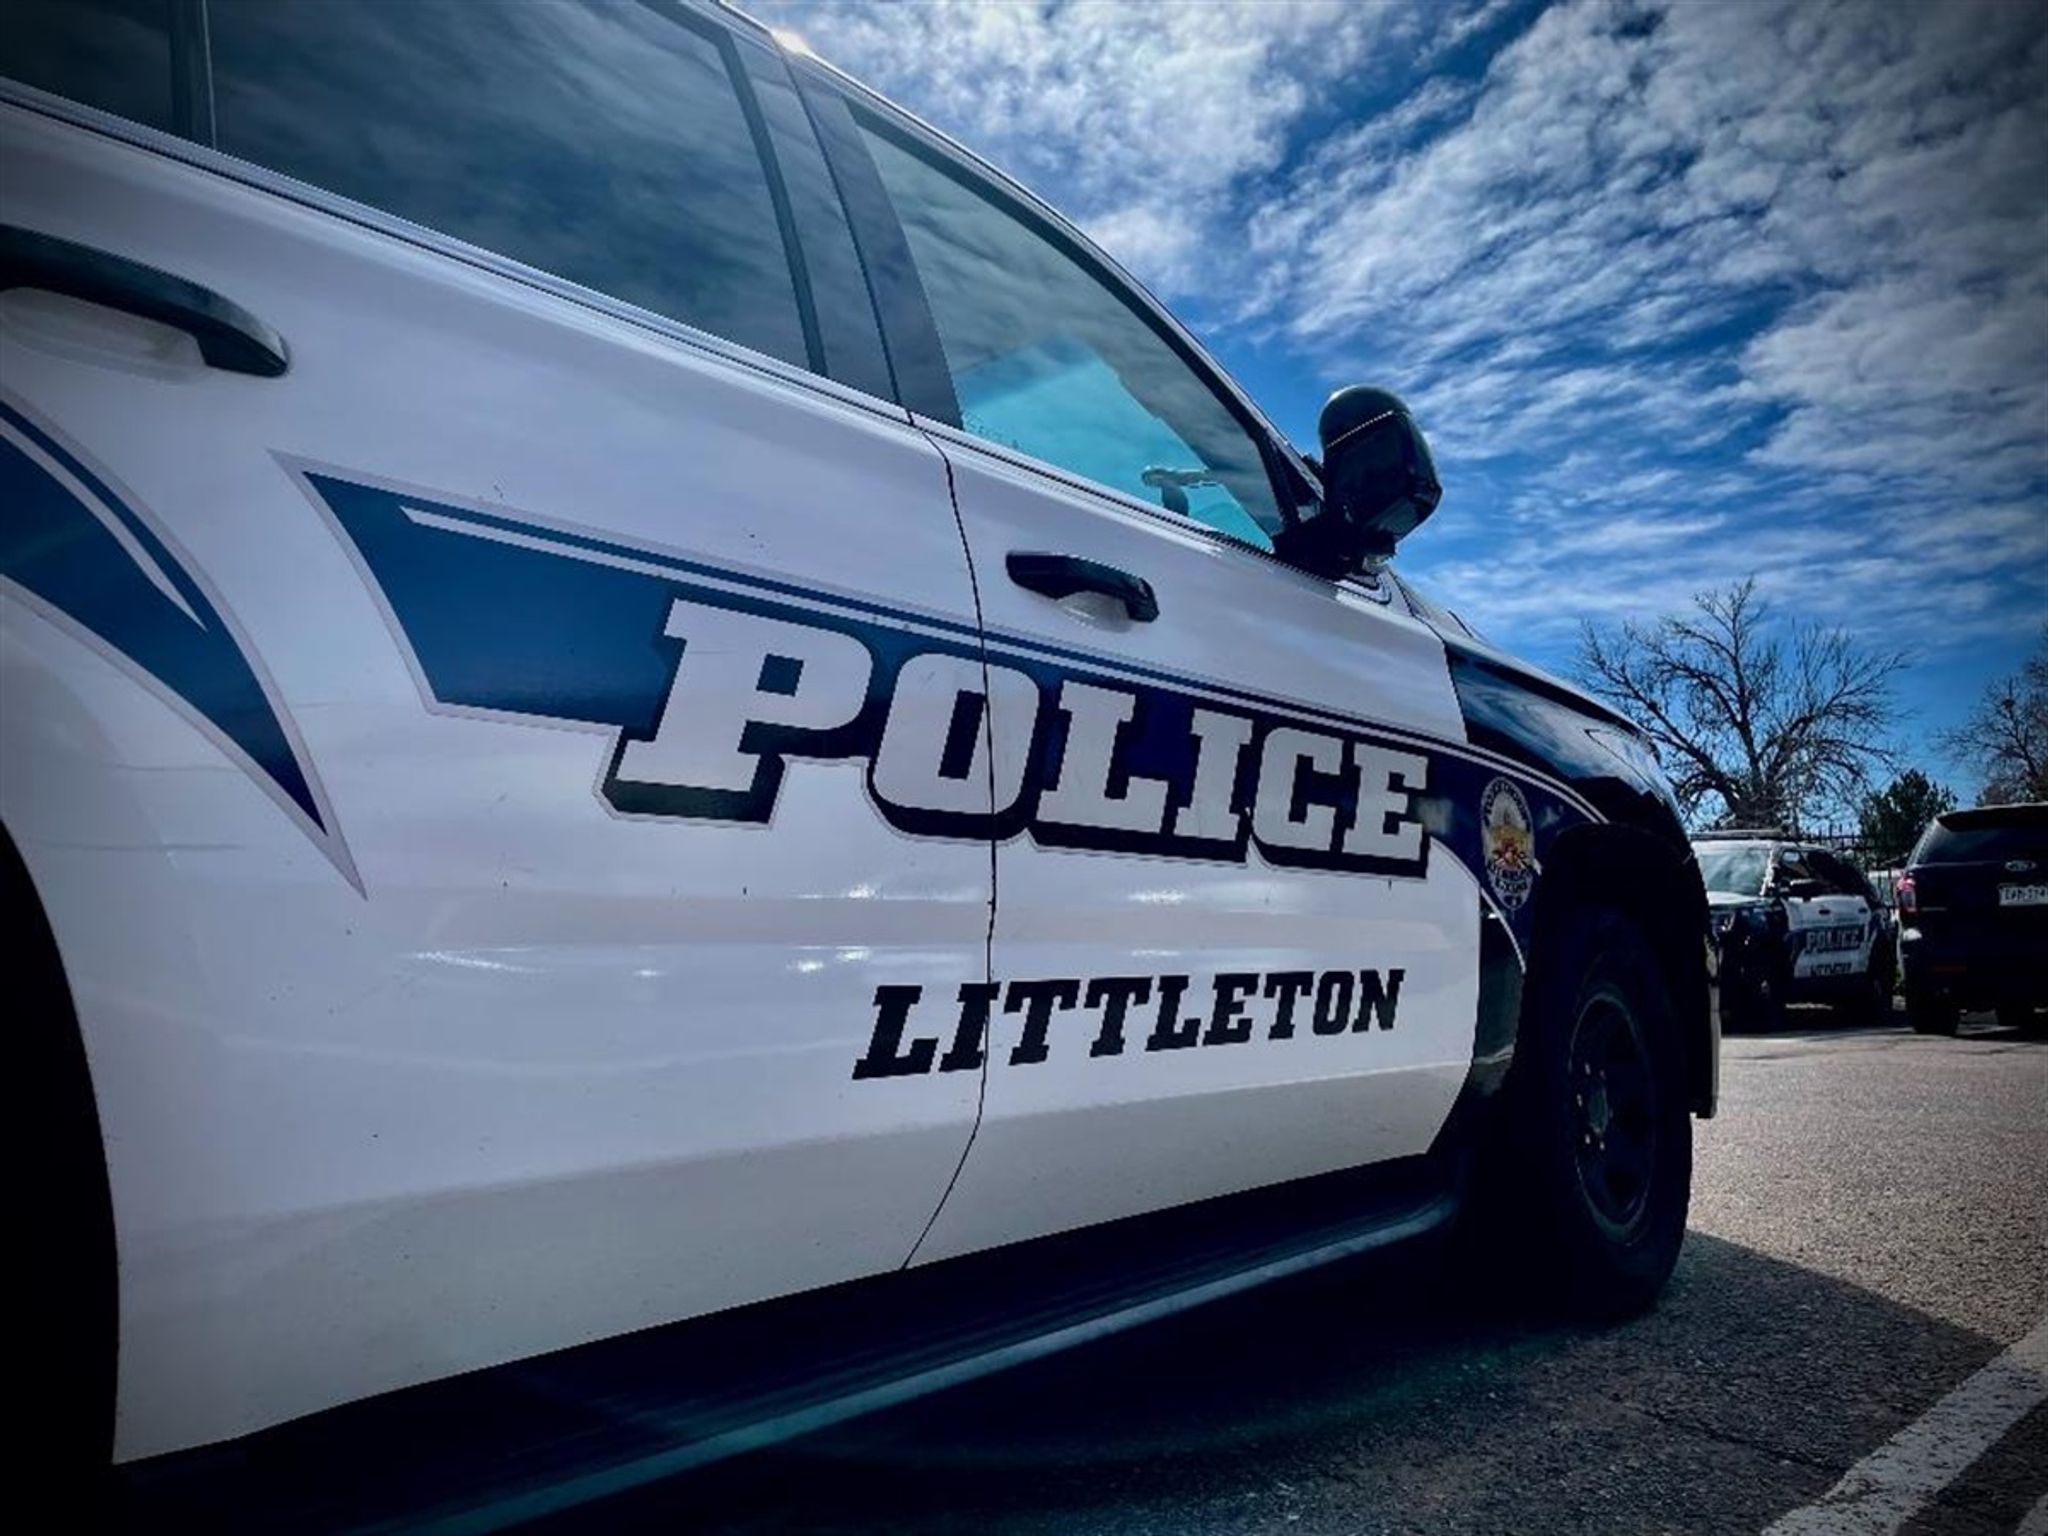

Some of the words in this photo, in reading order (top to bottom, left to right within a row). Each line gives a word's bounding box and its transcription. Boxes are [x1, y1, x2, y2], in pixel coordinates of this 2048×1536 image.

[614, 598, 1429, 861] POLICE
[1806, 929, 1860, 950] POLICE
[852, 968, 1406, 1080] LITTLETON
